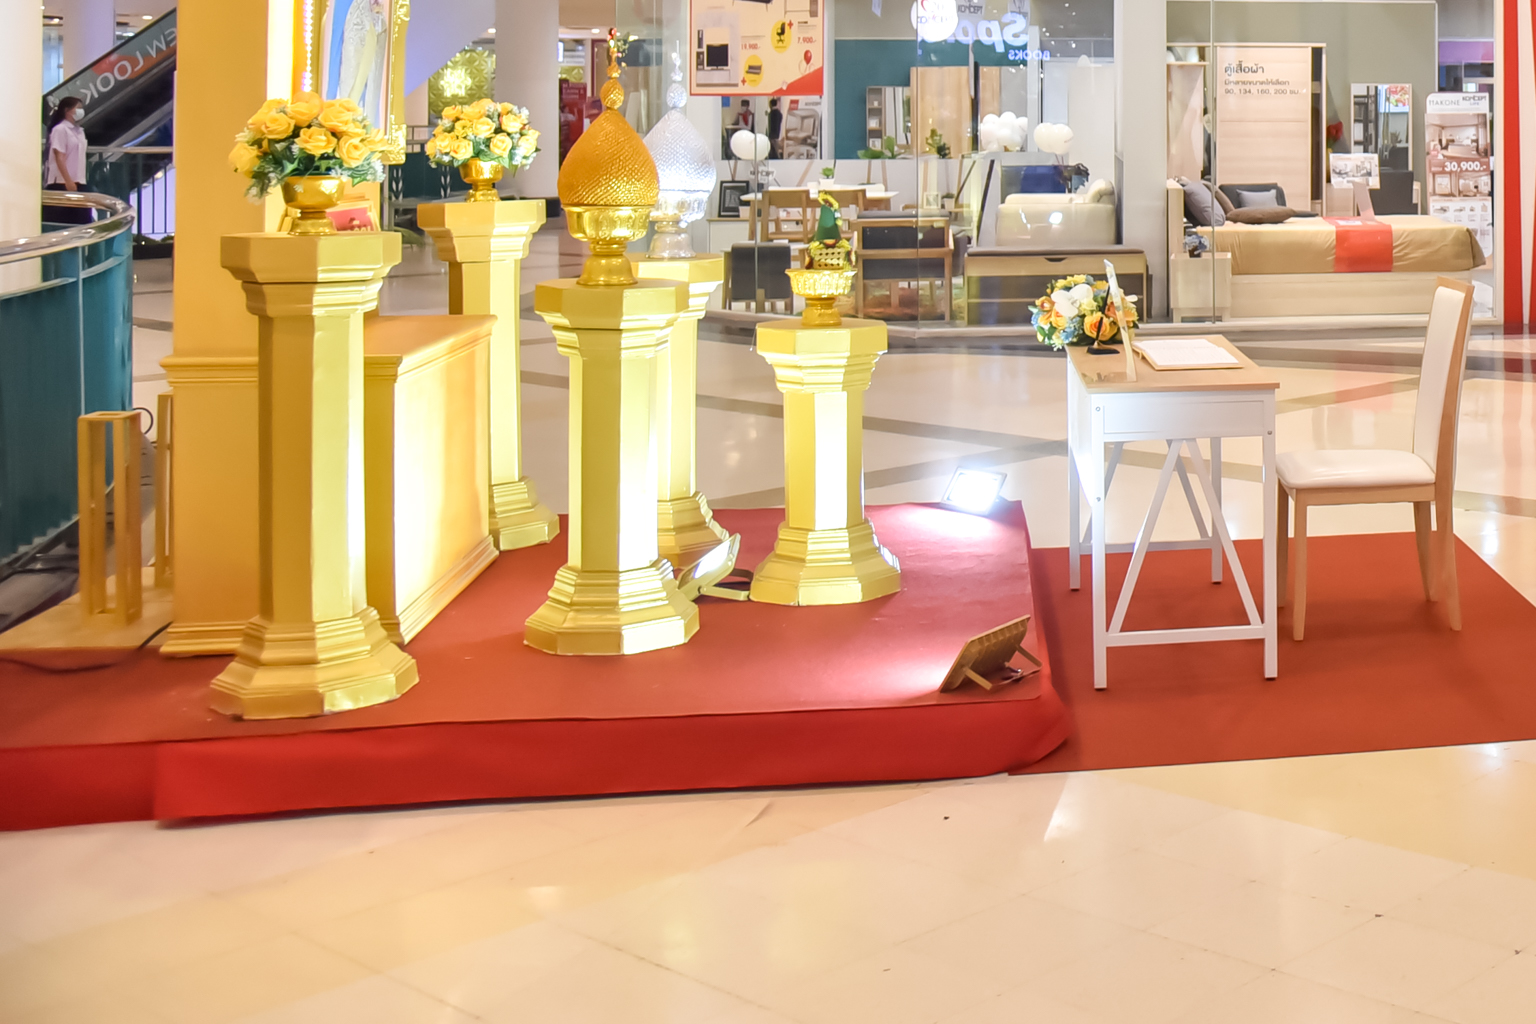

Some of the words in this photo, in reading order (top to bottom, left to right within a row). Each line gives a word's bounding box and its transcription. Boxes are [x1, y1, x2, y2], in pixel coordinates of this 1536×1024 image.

[1224, 60, 1265, 77] ตู้เสื้อผ้า
[1444, 161, 1487, 173] 30,900.-
